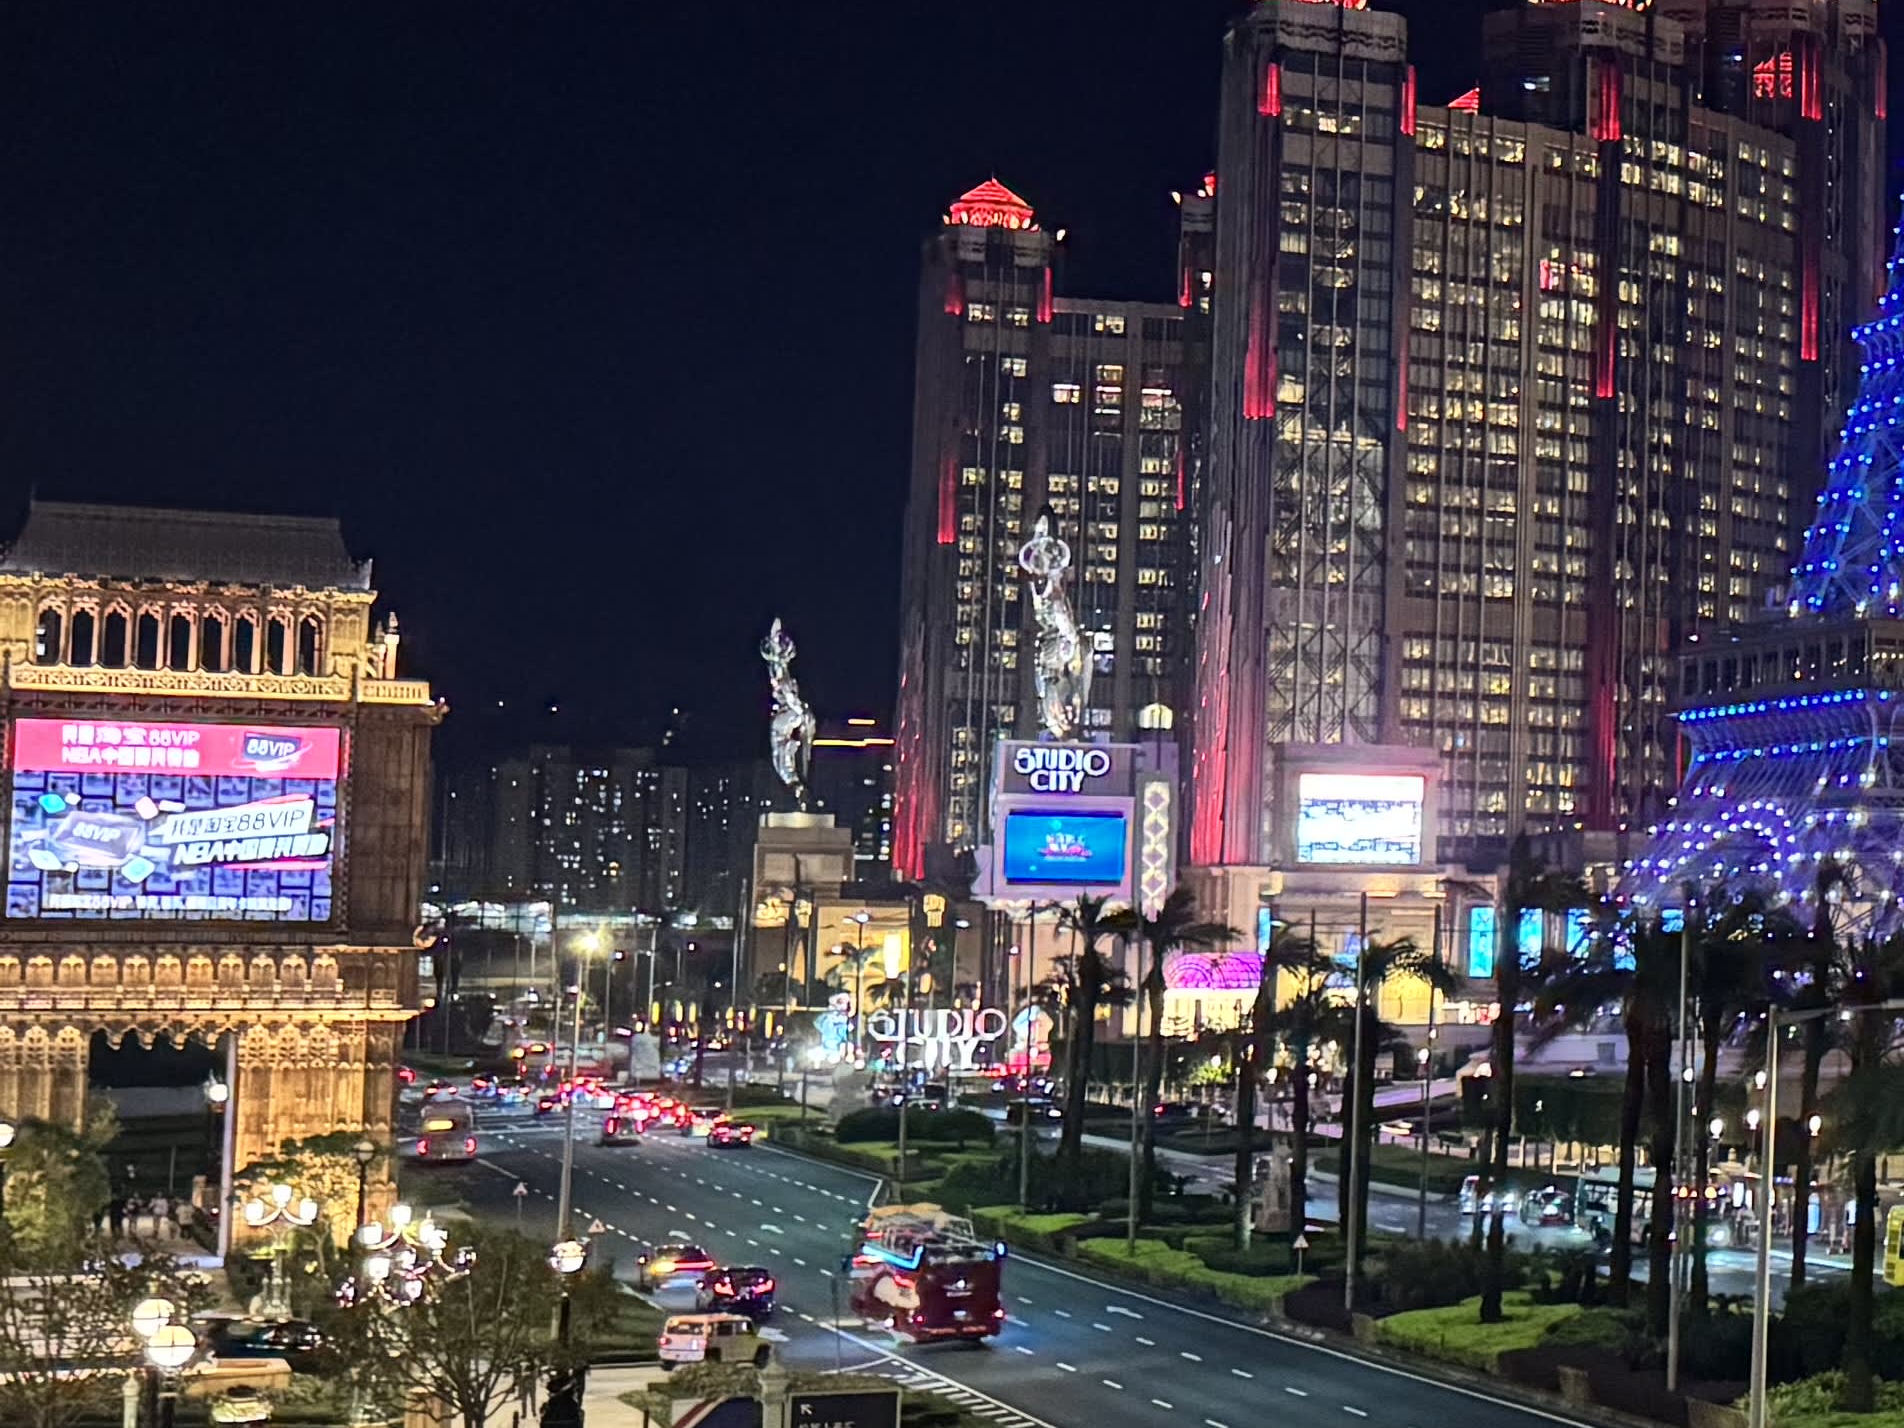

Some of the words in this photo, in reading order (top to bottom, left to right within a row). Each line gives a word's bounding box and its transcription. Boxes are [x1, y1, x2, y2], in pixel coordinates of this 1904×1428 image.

[1014, 748, 1111, 776] STUDIO
[1030, 771, 1085, 792] CITY
[867, 1008, 1008, 1041] STUDIO
